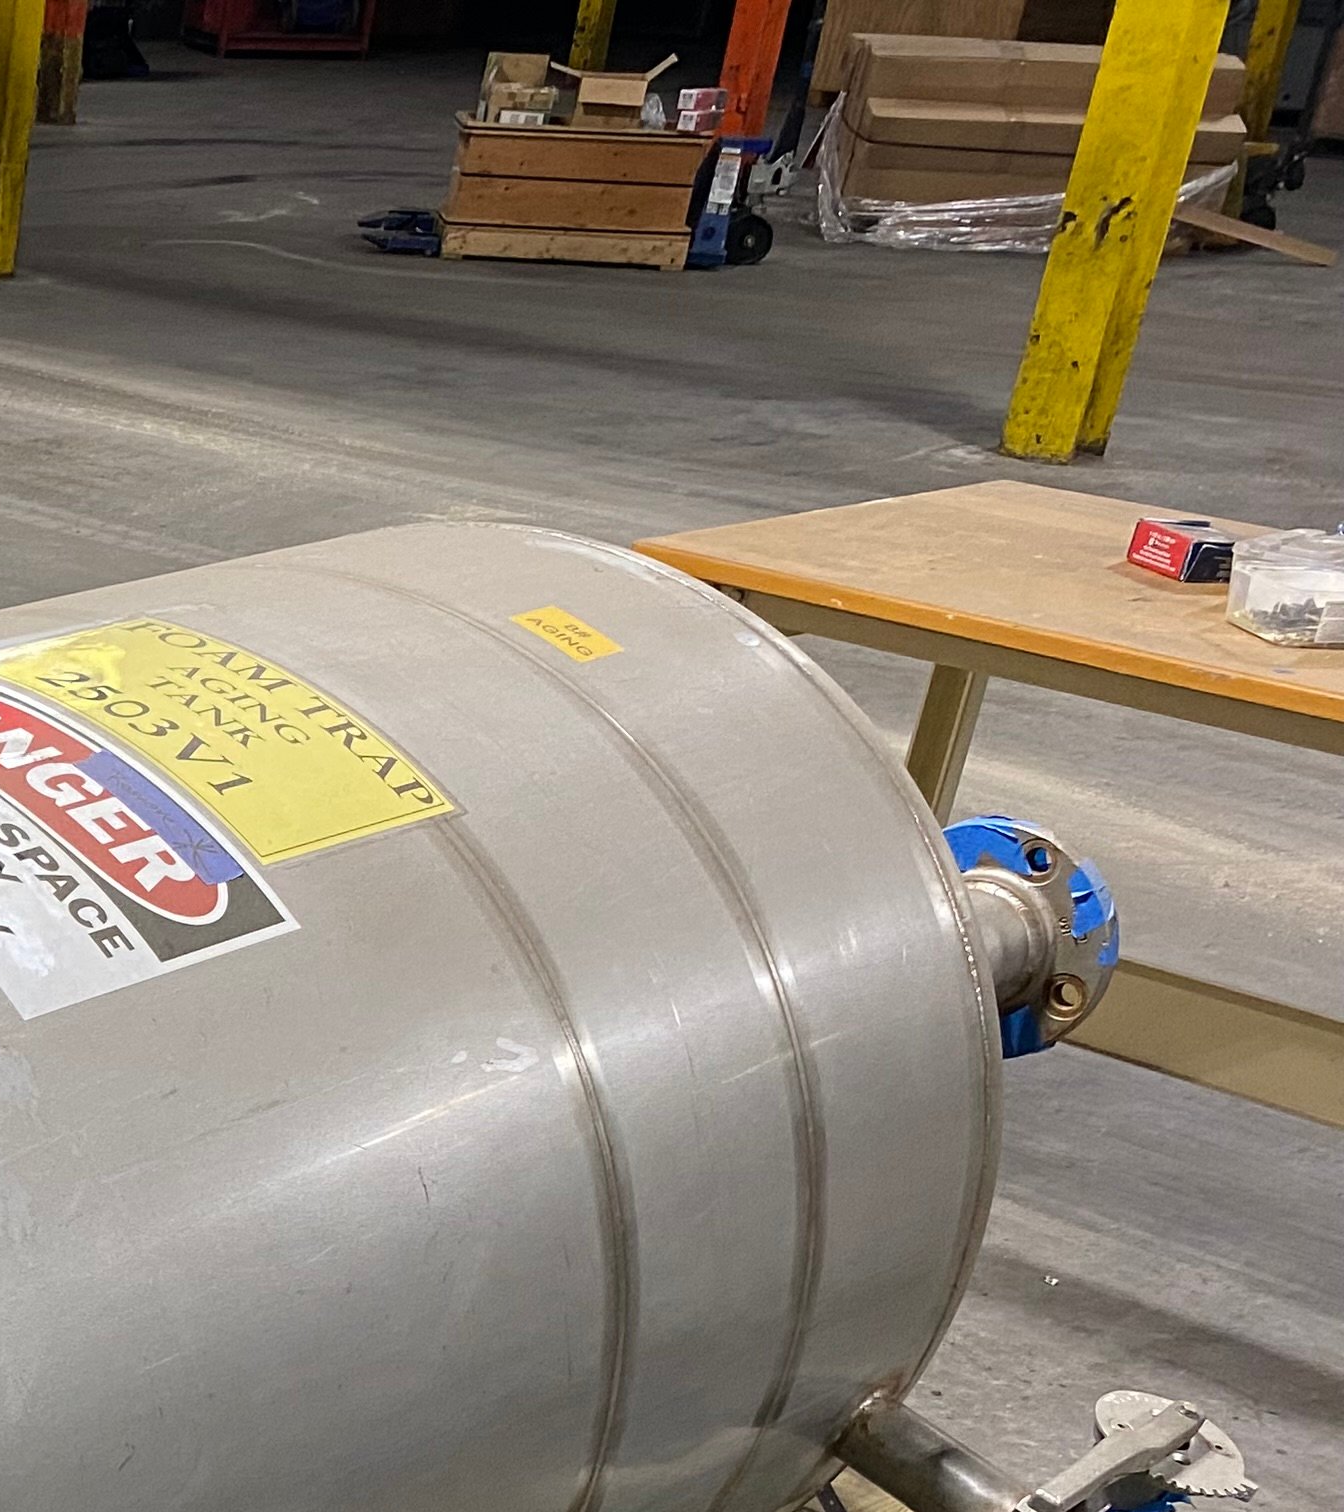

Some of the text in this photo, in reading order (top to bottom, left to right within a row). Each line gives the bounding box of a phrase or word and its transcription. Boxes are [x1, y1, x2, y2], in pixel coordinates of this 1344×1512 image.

[525, 618, 593, 657] AGING
[119, 622, 434, 805] FOAM TRAP
[146, 676, 266, 749] TANK
[165, 666, 311, 745] AGING
